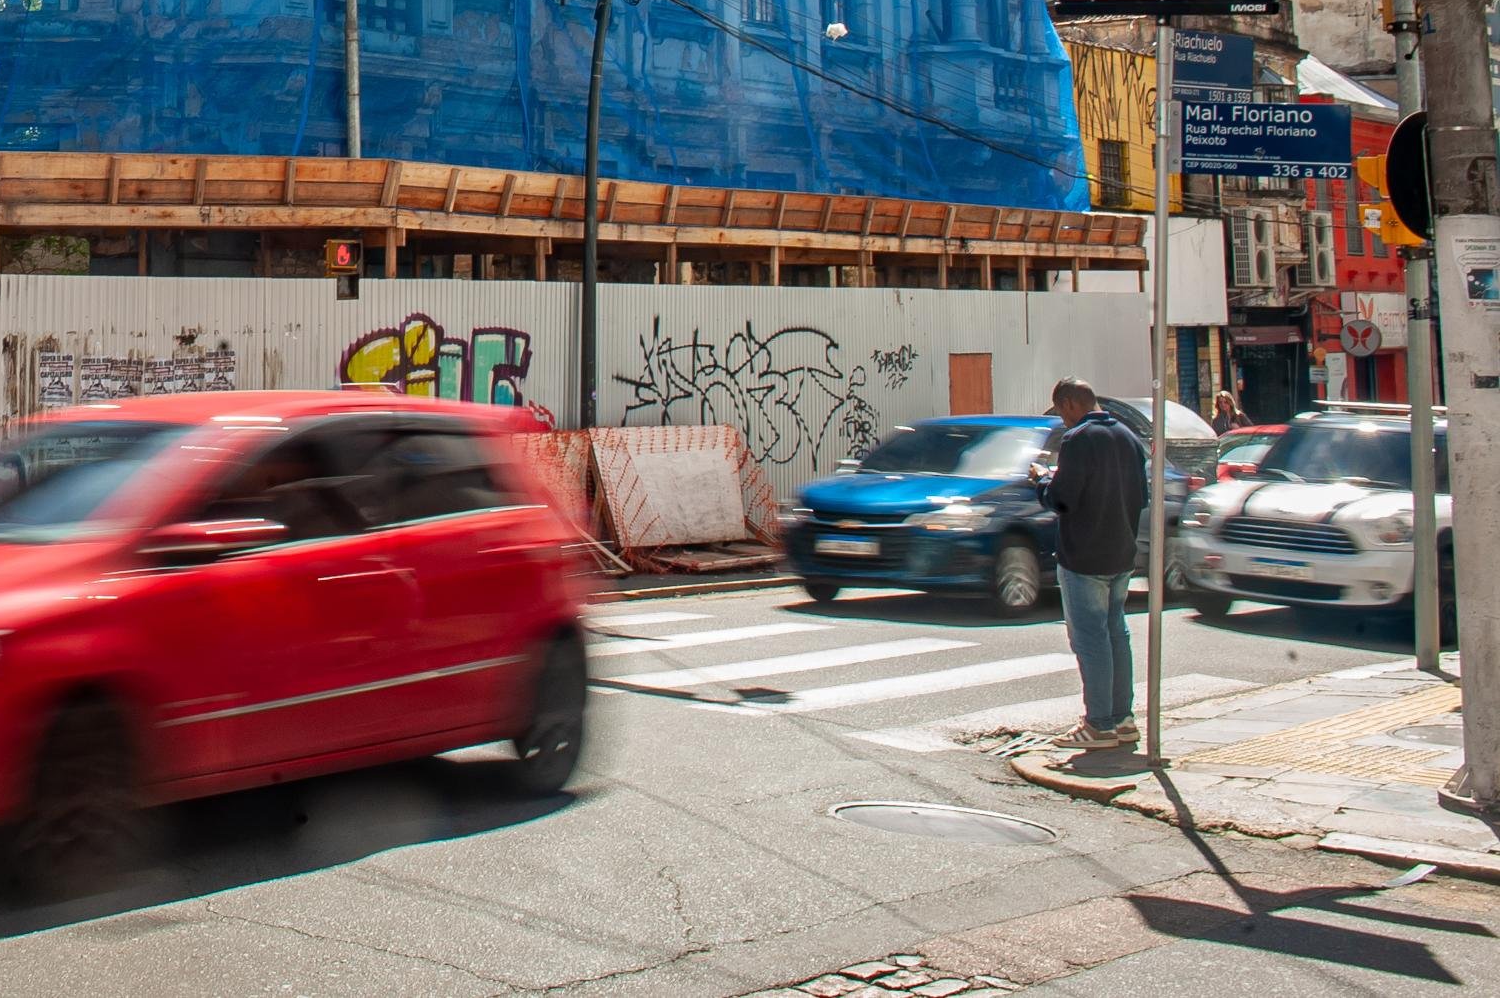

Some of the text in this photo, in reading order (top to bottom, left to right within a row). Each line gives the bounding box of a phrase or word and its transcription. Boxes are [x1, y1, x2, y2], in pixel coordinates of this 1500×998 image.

[1175, 33, 1223, 51] Riachuelo
[1175, 51, 1217, 64] Rua Riachuelo
[1208, 90, 1225, 102] 1501
[1227, 93, 1232, 102] a
[1185, 105, 1313, 123] Mal. Floriano
[1185, 124, 1317, 137] Rua Marechal Floriano
[1185, 134, 1227, 146] Peixoto
[1185, 161, 1199, 169] CEP
[1272, 164, 1348, 178] 336 a 402
